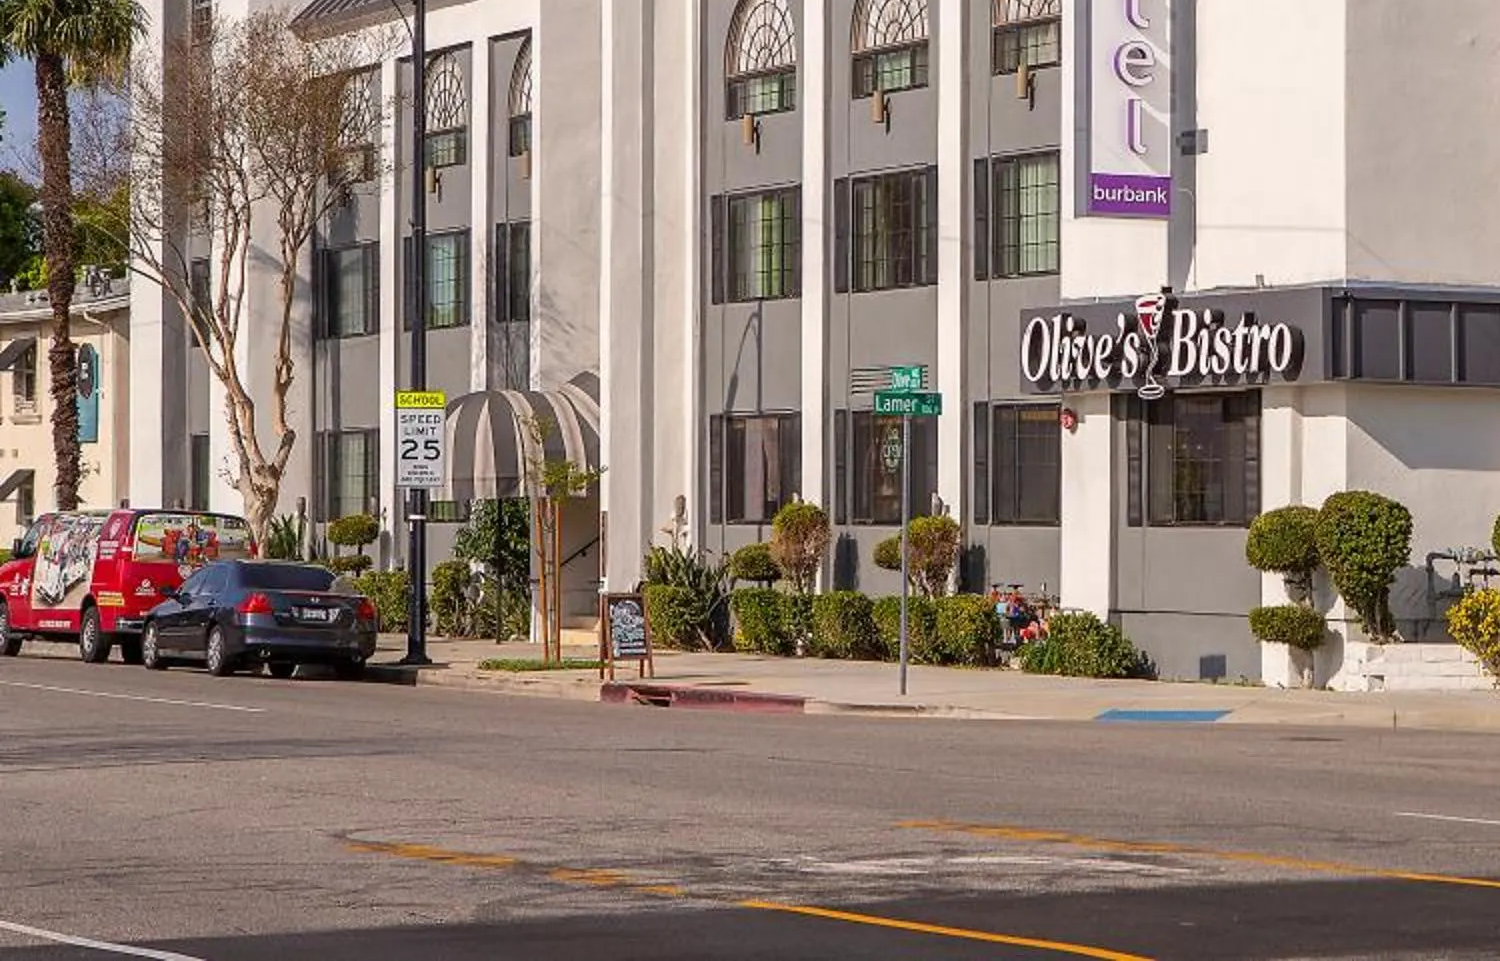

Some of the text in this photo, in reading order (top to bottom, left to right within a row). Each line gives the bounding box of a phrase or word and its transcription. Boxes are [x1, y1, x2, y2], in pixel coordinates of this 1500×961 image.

[1093, 184, 1168, 204] burbank
[1021, 308, 1293, 382] Olive's Bistro
[400, 394, 443, 406] SCHOOL
[875, 394, 918, 412] Lamer
[400, 414, 441, 424] SPEED
[404, 426, 437, 436] LIMIT
[401, 439, 440, 460] 25
